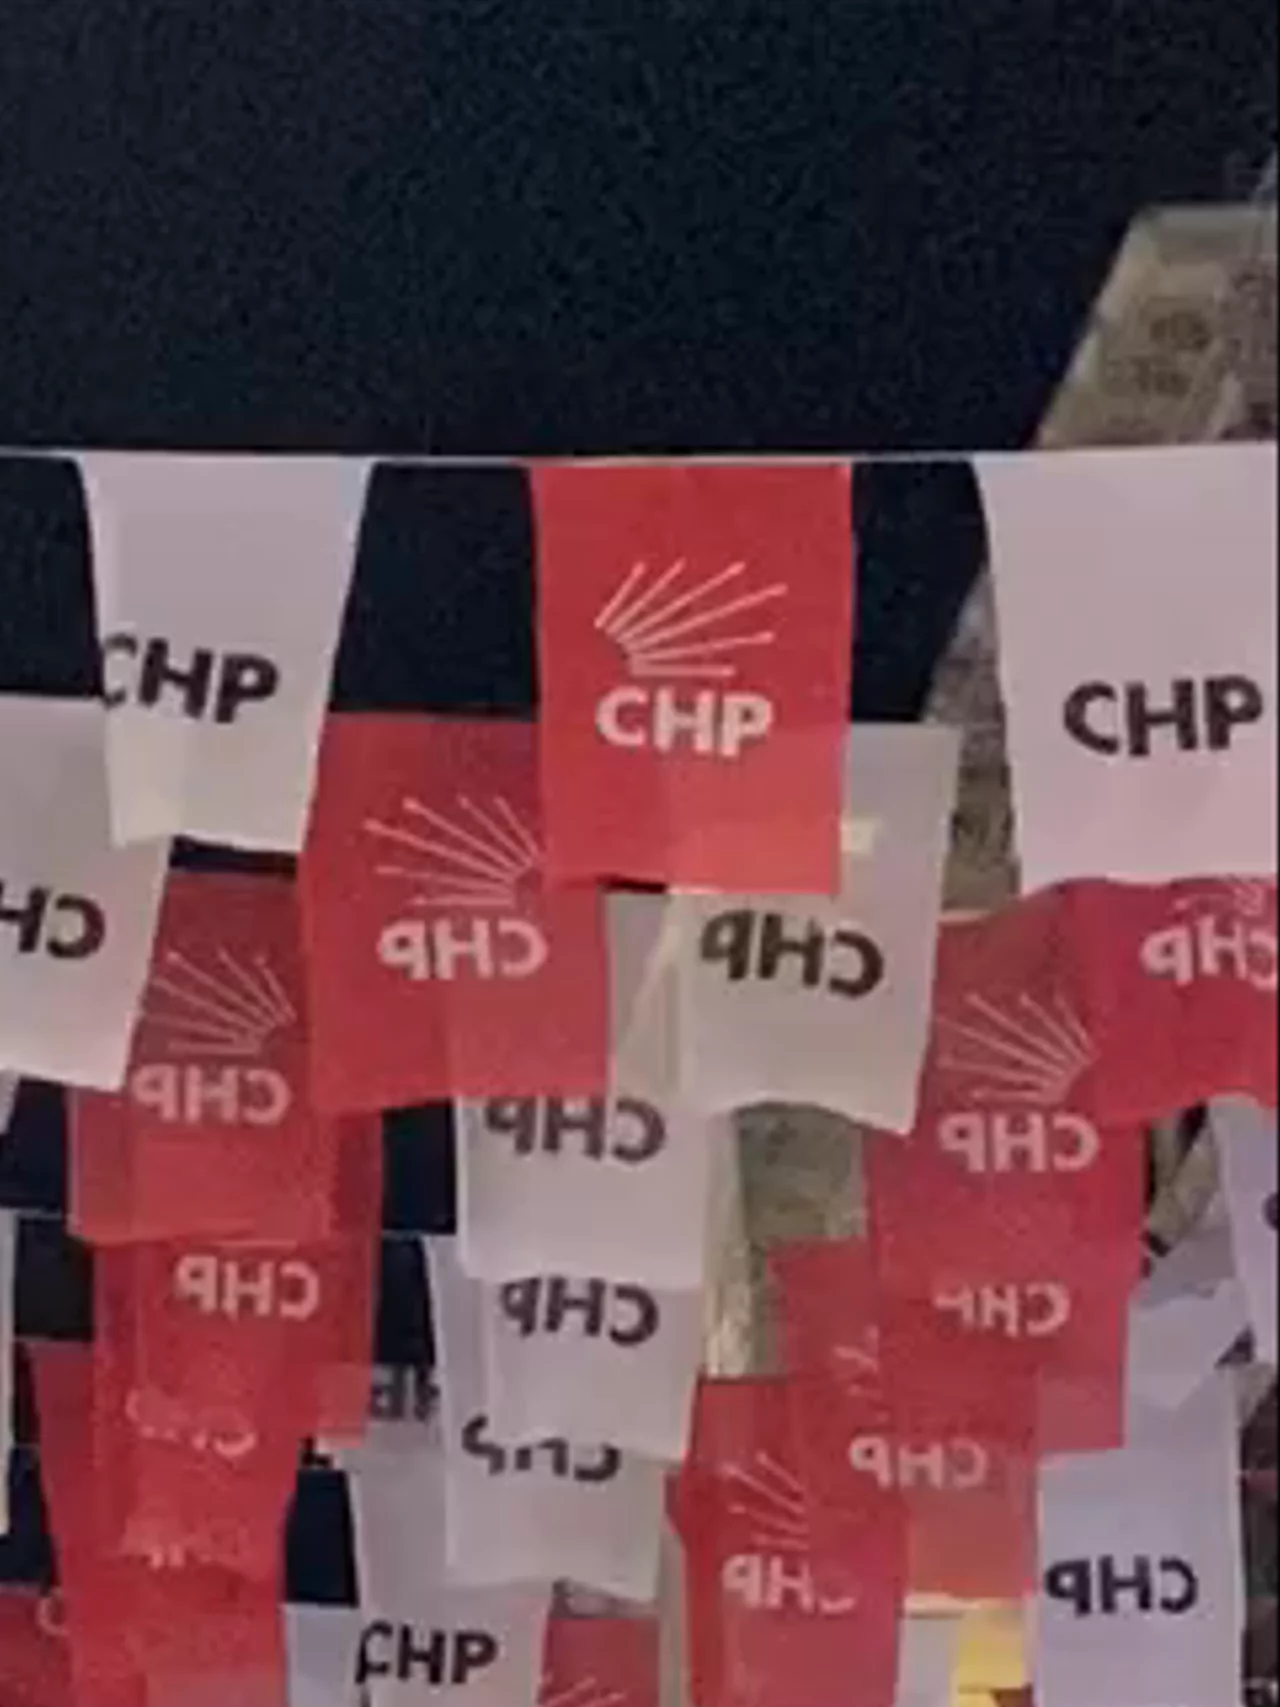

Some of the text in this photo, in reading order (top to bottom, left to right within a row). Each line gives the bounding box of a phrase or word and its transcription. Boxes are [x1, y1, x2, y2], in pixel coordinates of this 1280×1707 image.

[101, 633, 279, 723] CHP
[594, 686, 773, 757] CHP
[1062, 676, 1264, 757] CHP
[355, 1620, 499, 1685] CHP
